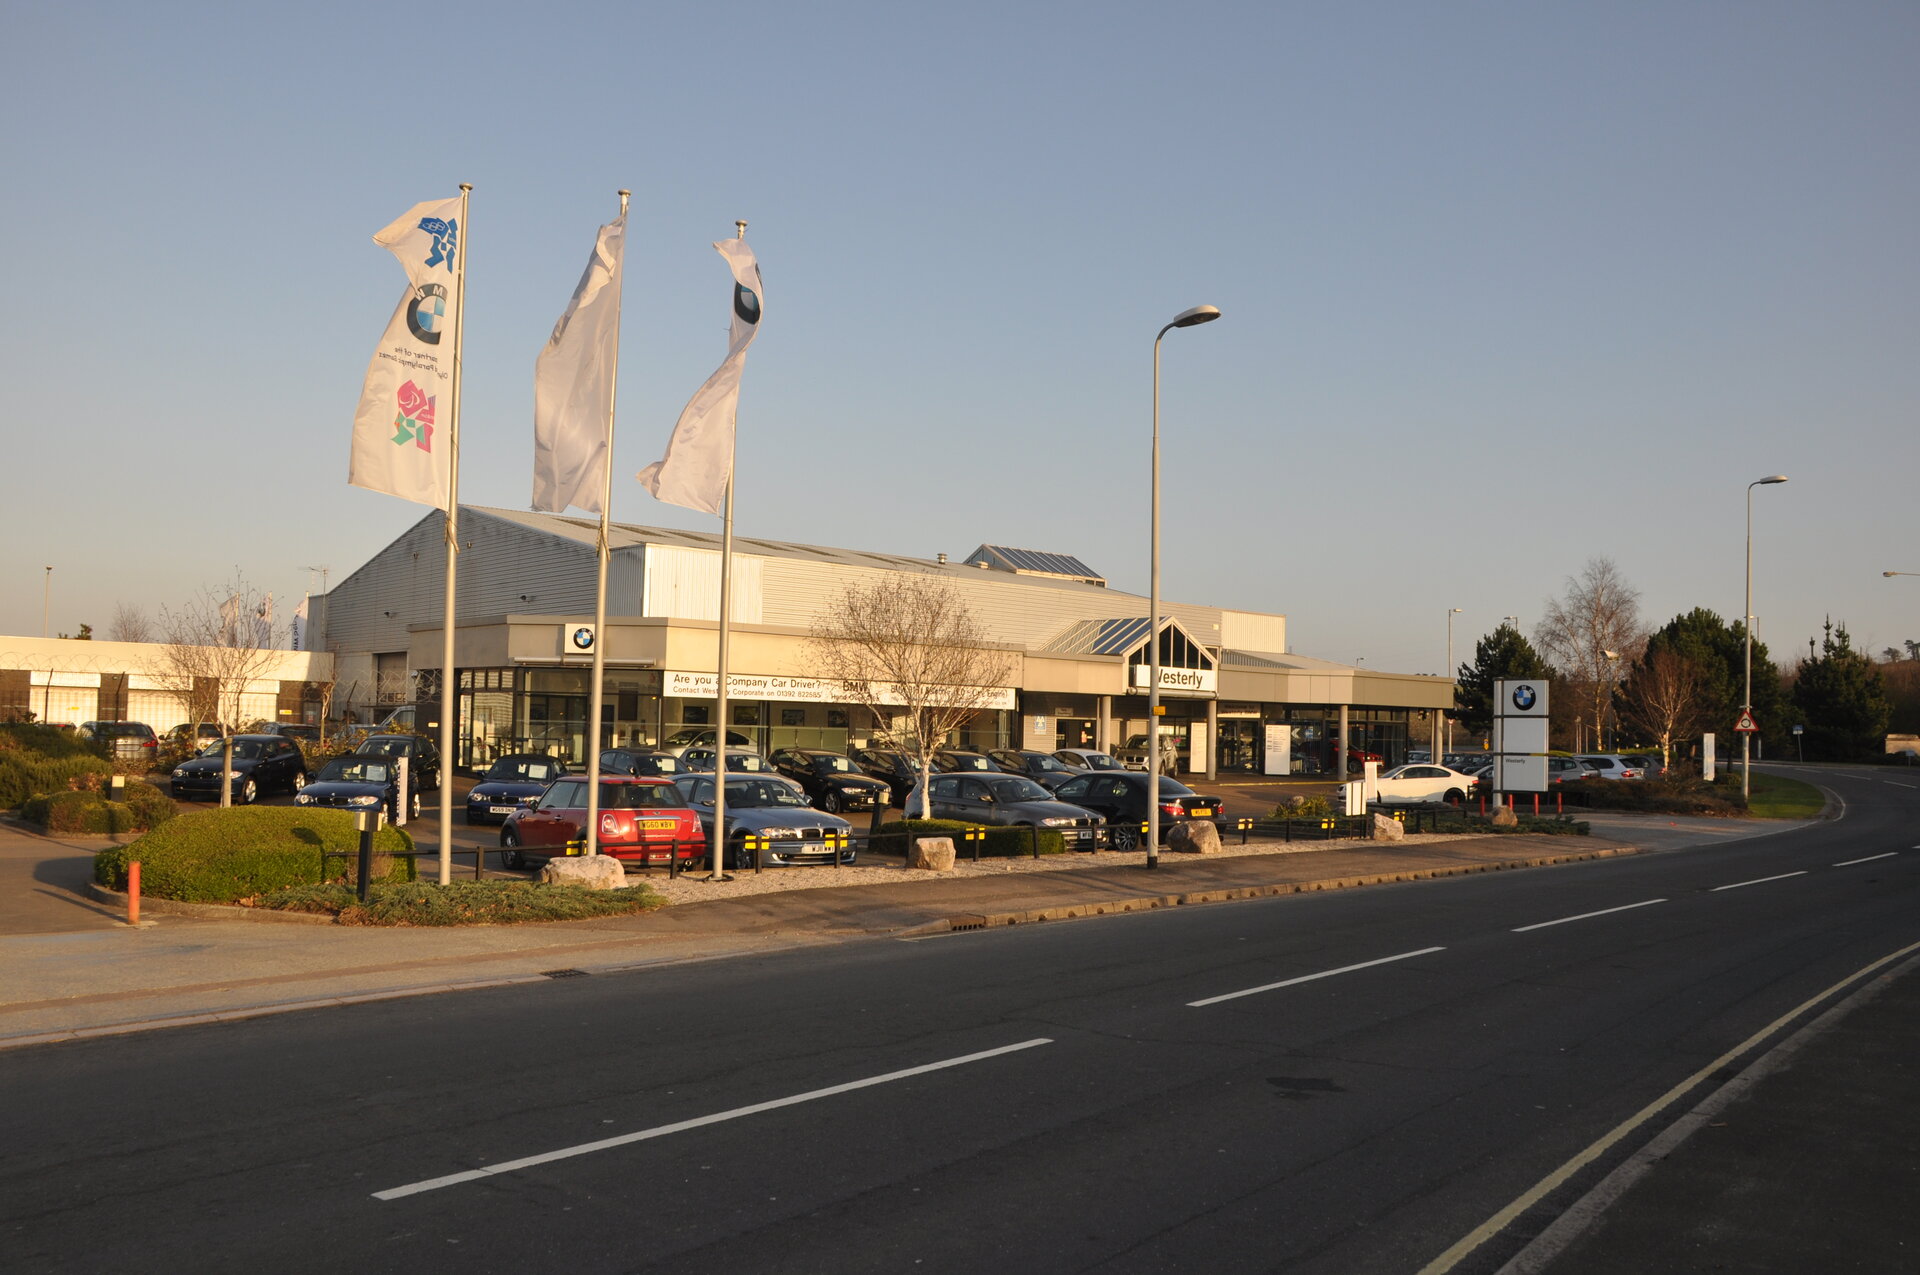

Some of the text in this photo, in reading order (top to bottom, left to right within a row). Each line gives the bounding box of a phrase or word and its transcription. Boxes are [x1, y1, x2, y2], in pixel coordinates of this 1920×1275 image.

[673, 674, 690, 684] Are
[694, 676, 712, 685] you
[726, 676, 768, 688] Company
[771, 678, 787, 688] Car
[790, 679, 821, 689] Driver?
[1158, 669, 1203, 689] esterly
[673, 686, 700, 694] Contact
[702, 687, 730, 696] Westy
[732, 689, 764, 698] Corporate
[776, 690, 796, 698] 01392
